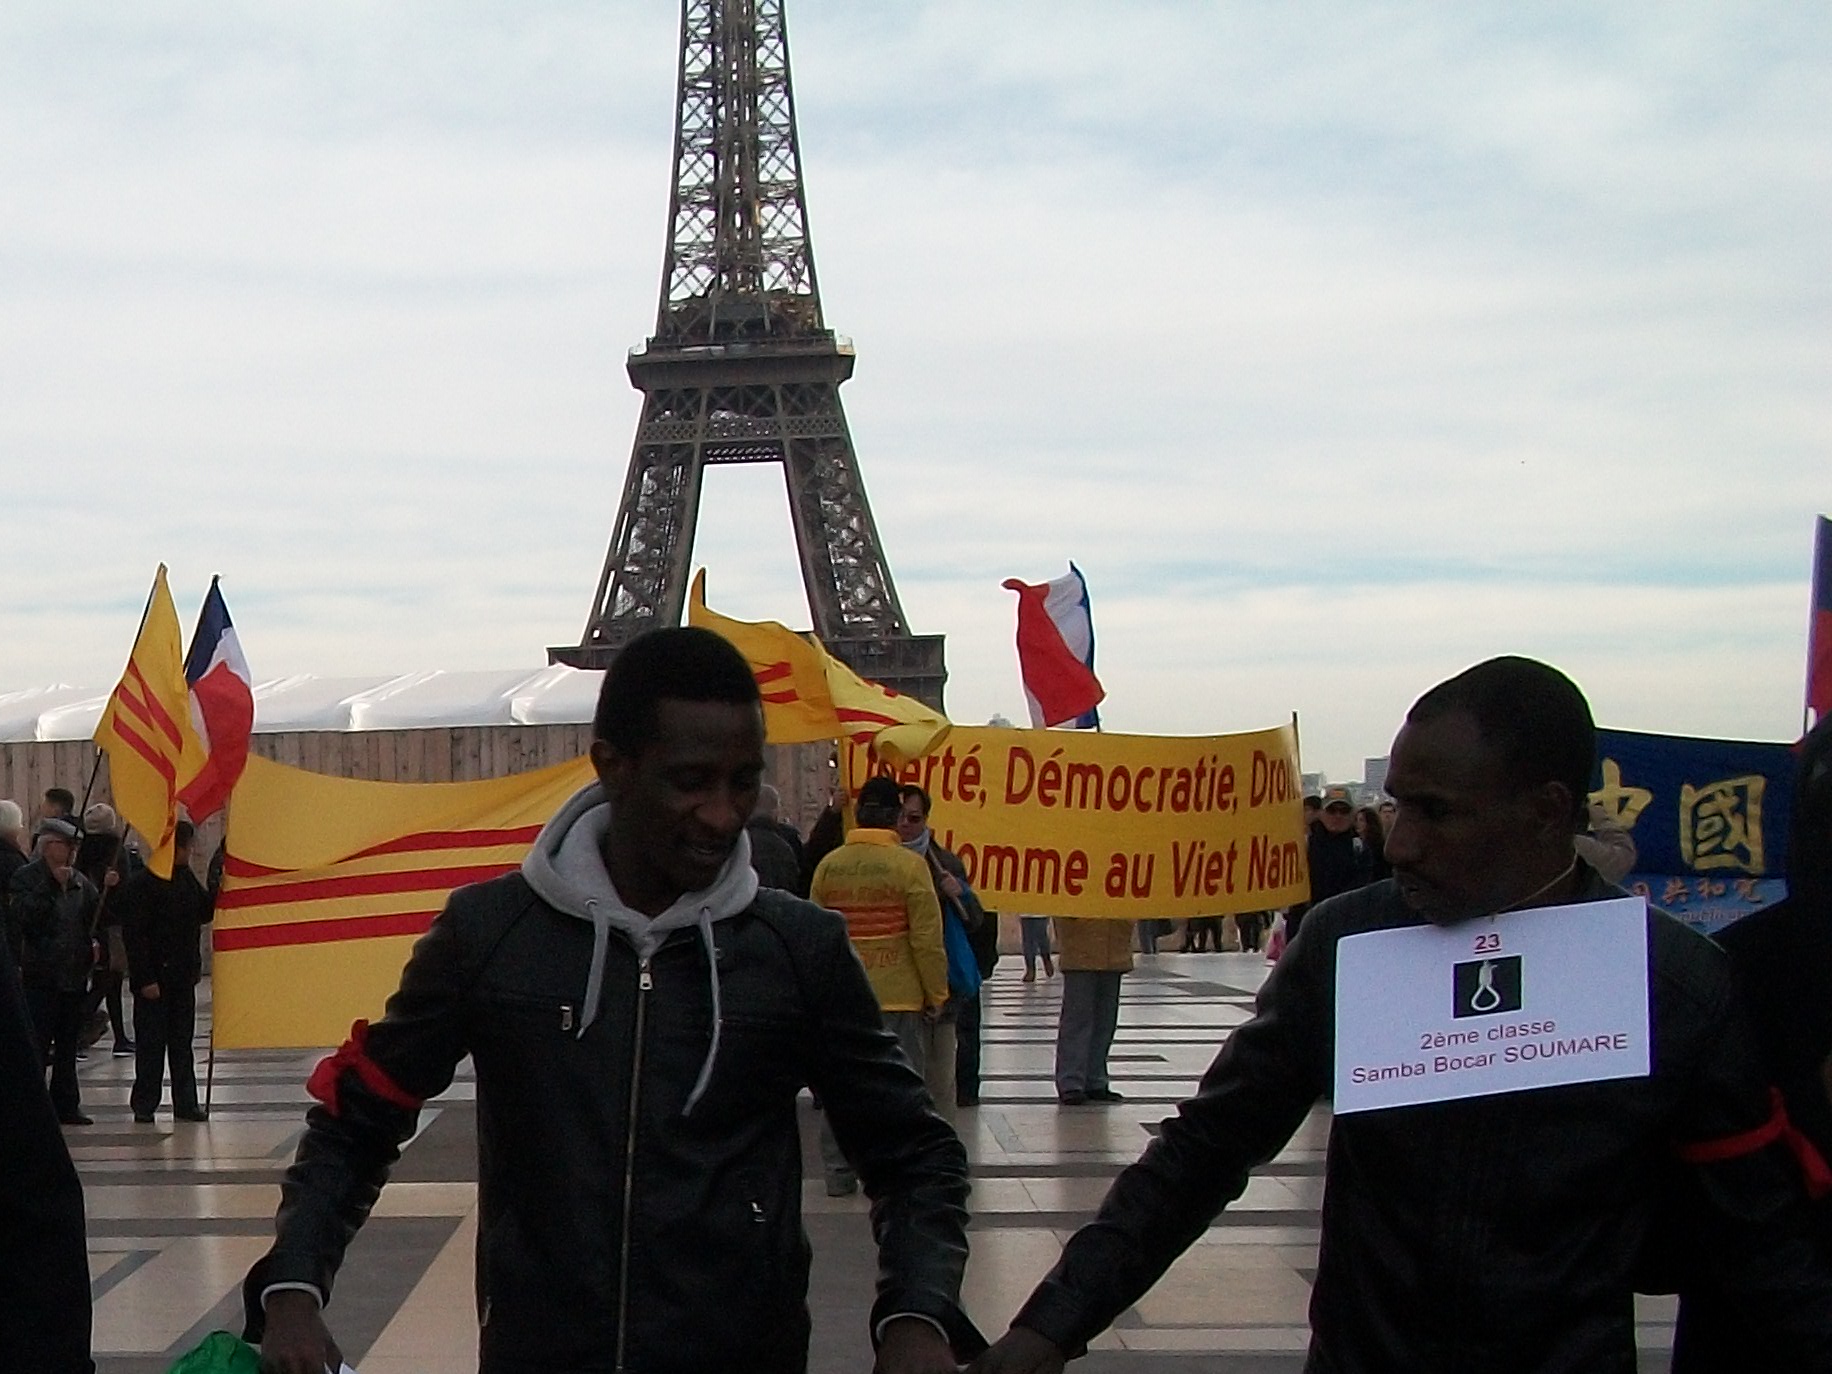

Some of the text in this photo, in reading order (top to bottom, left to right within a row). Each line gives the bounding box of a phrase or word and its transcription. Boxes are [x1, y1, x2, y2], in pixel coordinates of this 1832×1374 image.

[1005, 746, 1238, 815] Démocratie,
[1105, 851, 1155, 899] au
[1172, 839, 1238, 899] Viet
[1474, 932, 1502, 954] 23
[1351, 1033, 1629, 1086] Samba Bocar SOUMARE
[1420, 1018, 1556, 1051] 2ème classe
